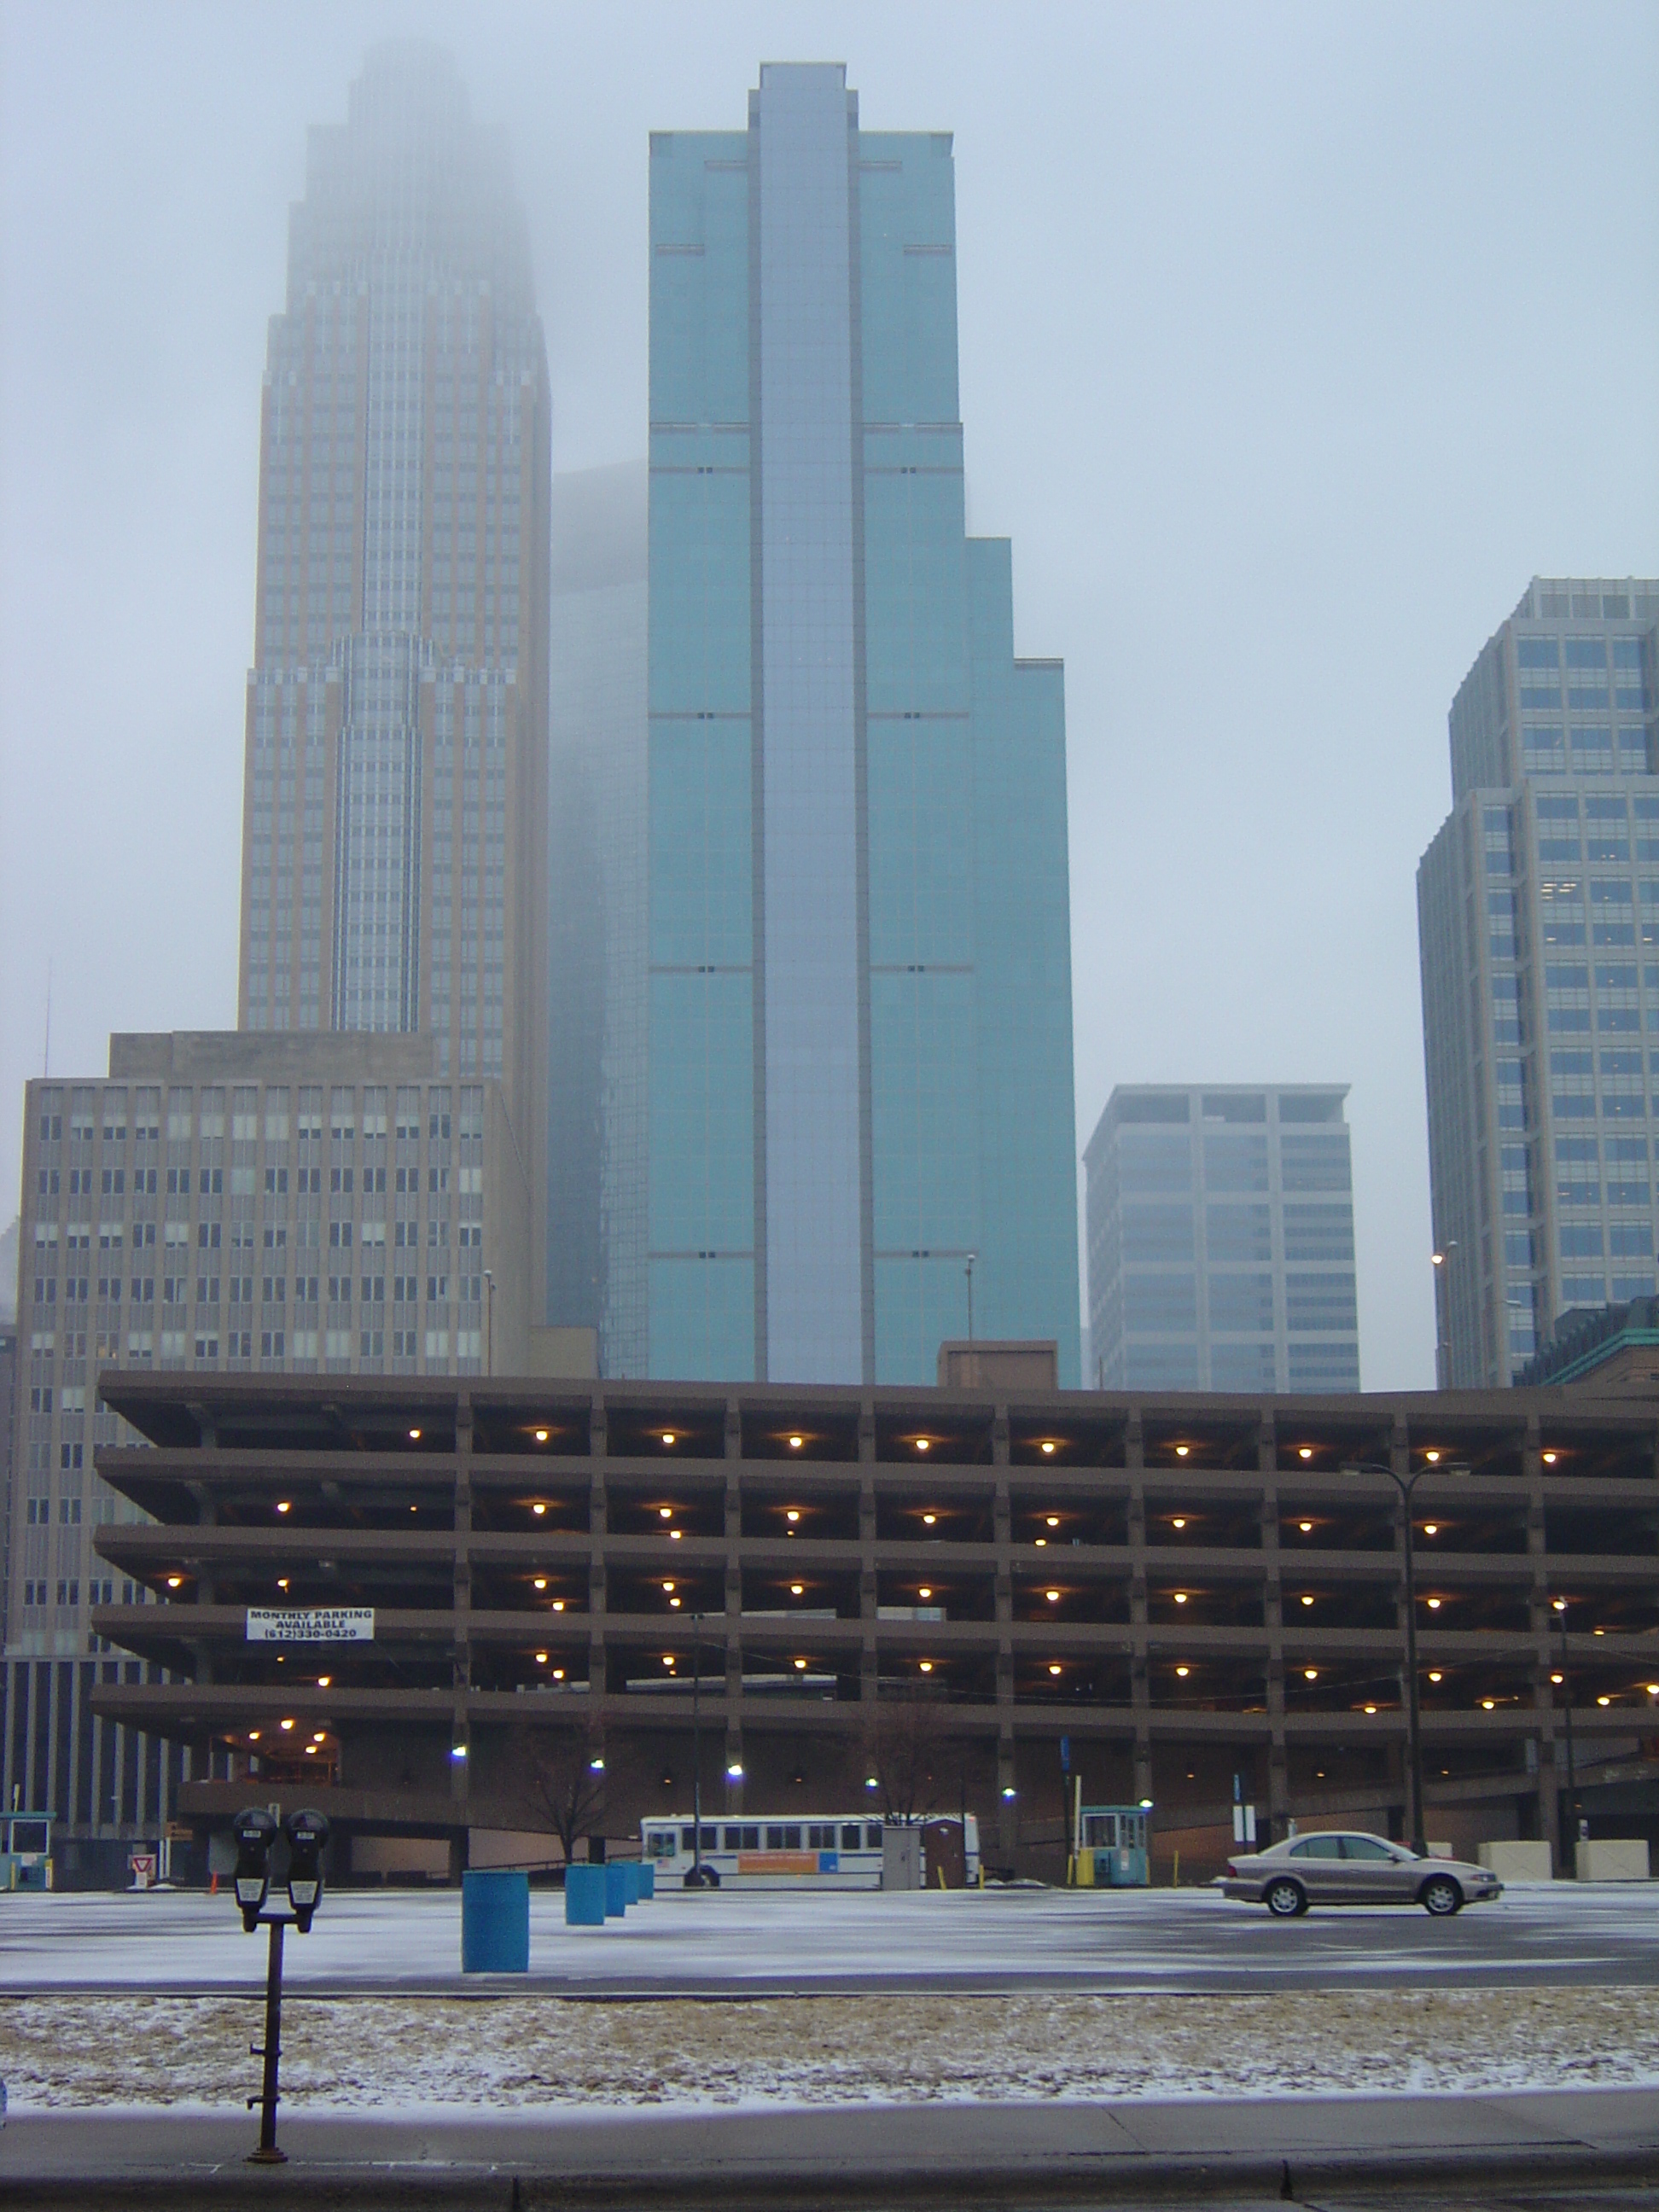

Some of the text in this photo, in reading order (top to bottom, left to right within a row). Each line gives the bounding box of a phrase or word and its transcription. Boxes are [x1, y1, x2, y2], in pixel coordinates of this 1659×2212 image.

[251, 1610, 372, 1620] MONTHLY PARKING
[276, 1620, 346, 1628] AVAILABLE
